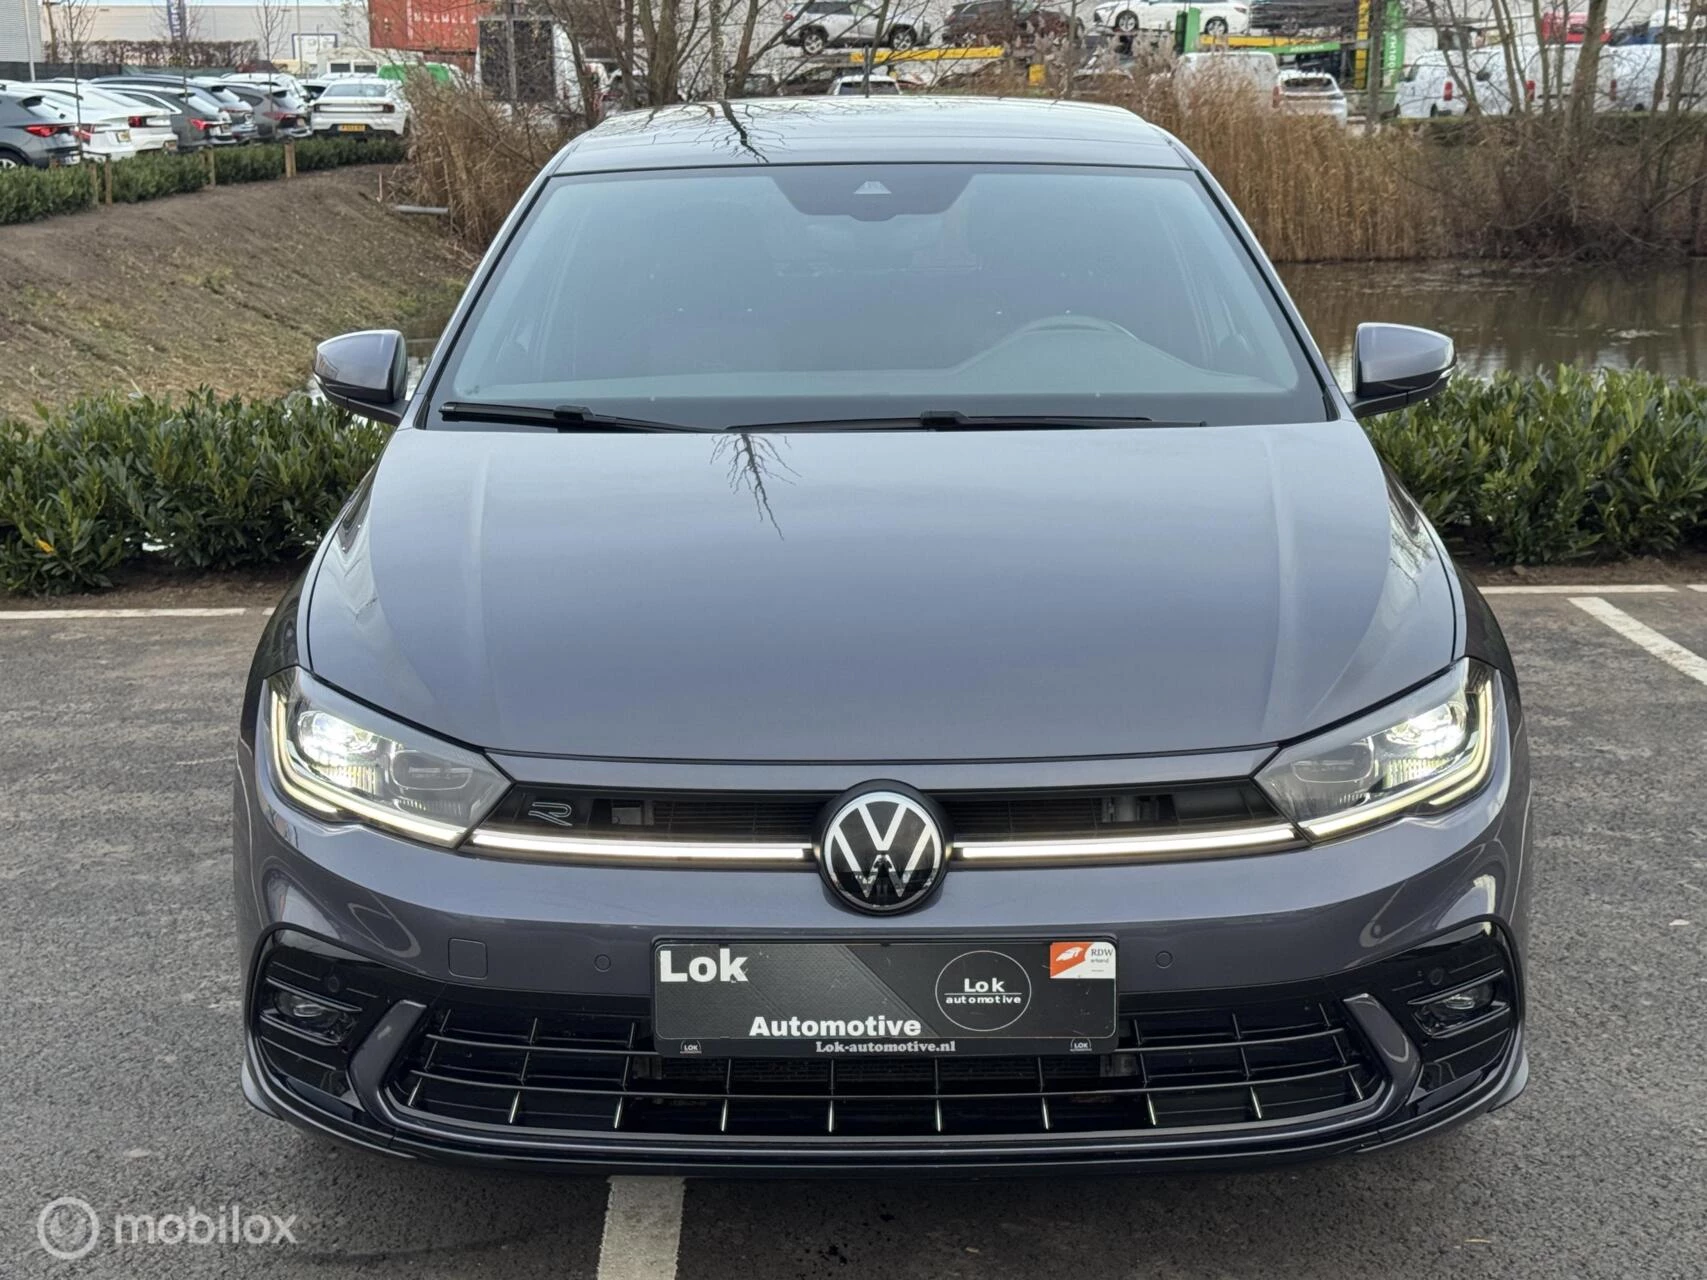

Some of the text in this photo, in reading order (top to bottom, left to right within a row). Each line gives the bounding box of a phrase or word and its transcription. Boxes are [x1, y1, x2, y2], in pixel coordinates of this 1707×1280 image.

[1091, 948, 1113, 956] RDW
[660, 948, 749, 982] Lok
[964, 977, 1005, 993] Lok
[945, 995, 1022, 1004] automotive
[749, 1015, 922, 1037] Automotive
[683, 1043, 698, 1051] LOK
[815, 1040, 956, 1053] Lok-automotive.nl
[1073, 1041, 1088, 1049] LOK
